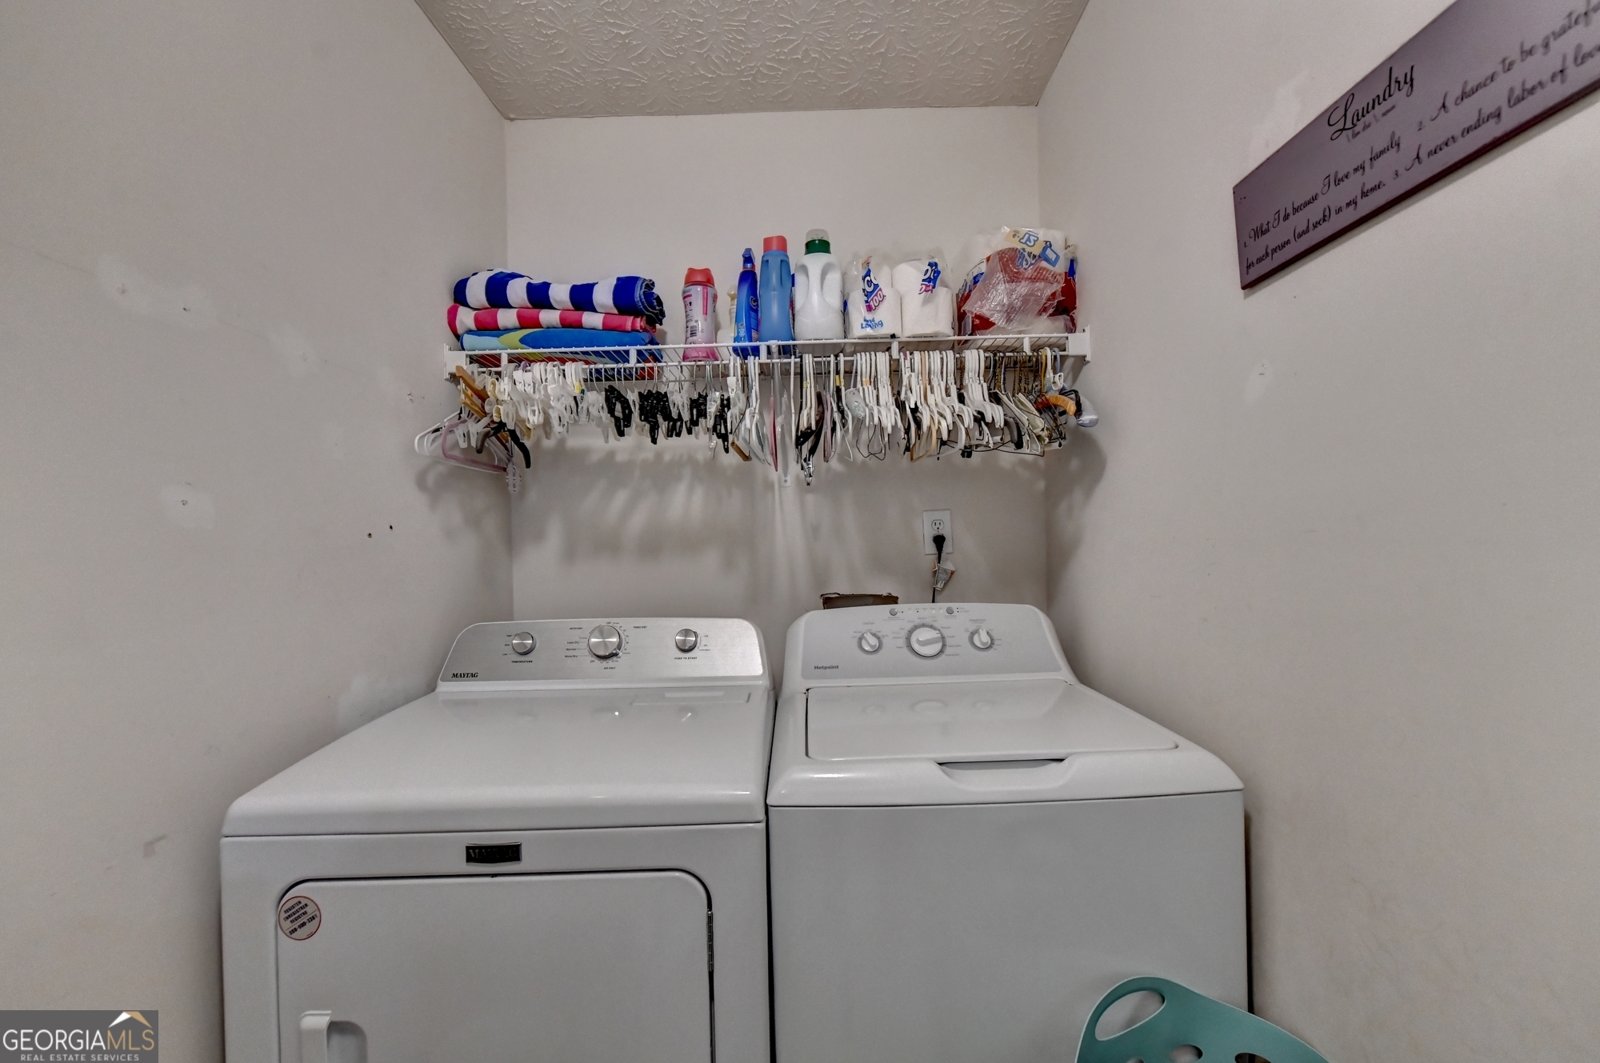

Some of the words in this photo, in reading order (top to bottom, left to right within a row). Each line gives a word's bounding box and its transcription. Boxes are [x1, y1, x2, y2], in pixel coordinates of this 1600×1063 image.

[1245, 257, 1256, 276] for
[1256, 249, 1270, 266] each
[1270, 239, 1292, 261] person
[1293, 225, 1310, 243] (and
[1312, 206, 1332, 230] sock)
[1334, 204, 1344, 216] in
[1345, 195, 1358, 213] my
[1360, 181, 1386, 200] home.
[1404, 144, 1423, 171] A
[1427, 133, 1458, 159] never
[1460, 105, 1503, 138] ending
[1507, 79, 1547, 109] labor
[1550, 54, 1568, 84] of
[1248, 222, 1270, 242] What
[1271, 209, 1281, 229] I
[1282, 208, 1291, 223] do
[1292, 192, 1319, 216] because
[1320, 174, 1331, 195] I
[1334, 170, 1350, 188] love
[1353, 161, 1366, 175] my
[1370, 133, 1401, 169] family
[1429, 91, 1449, 122] A
[1454, 71, 1497, 106] chance
[1500, 56, 1517, 74] to
[1519, 41, 1536, 62] be
[1327, 64, 1415, 141] Laundry
[451, 671, 479, 679] MAYTAG
